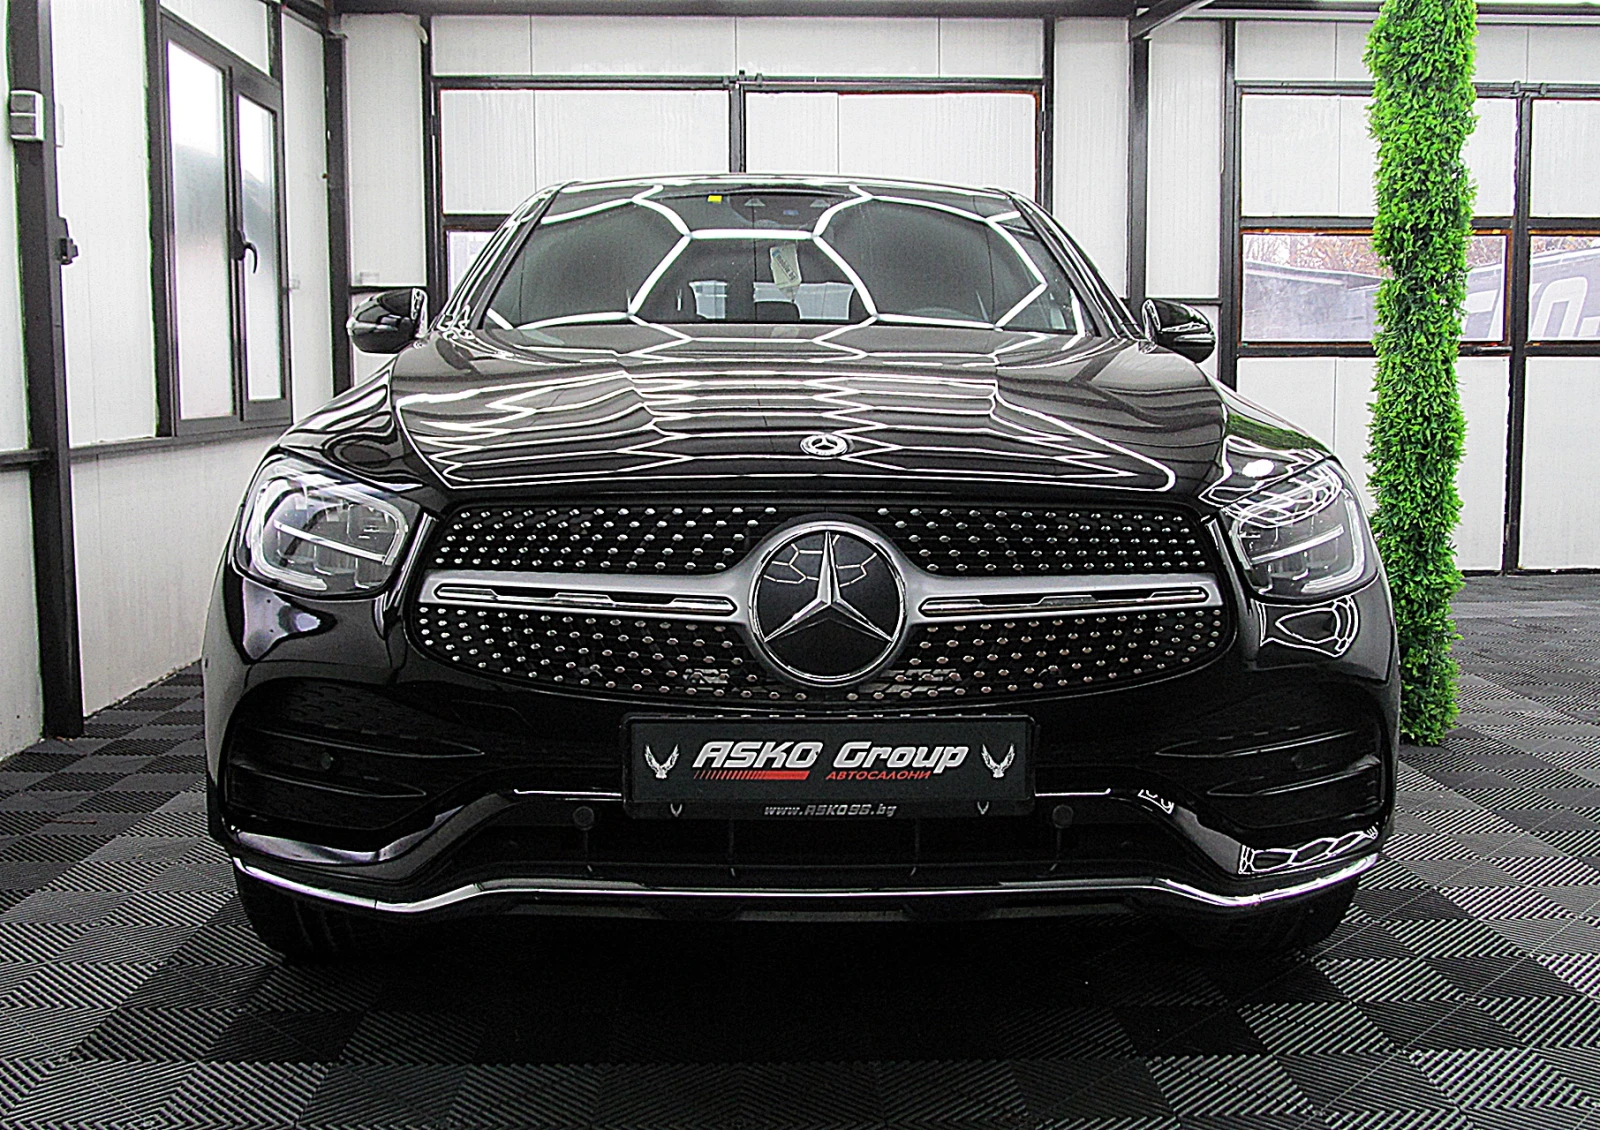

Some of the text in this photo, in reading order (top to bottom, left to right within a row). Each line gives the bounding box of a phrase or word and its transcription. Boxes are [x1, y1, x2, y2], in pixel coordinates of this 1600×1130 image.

[692, 741, 969, 774] ASKO Group
[824, 770, 932, 781] АВТОСАЛОНИ
